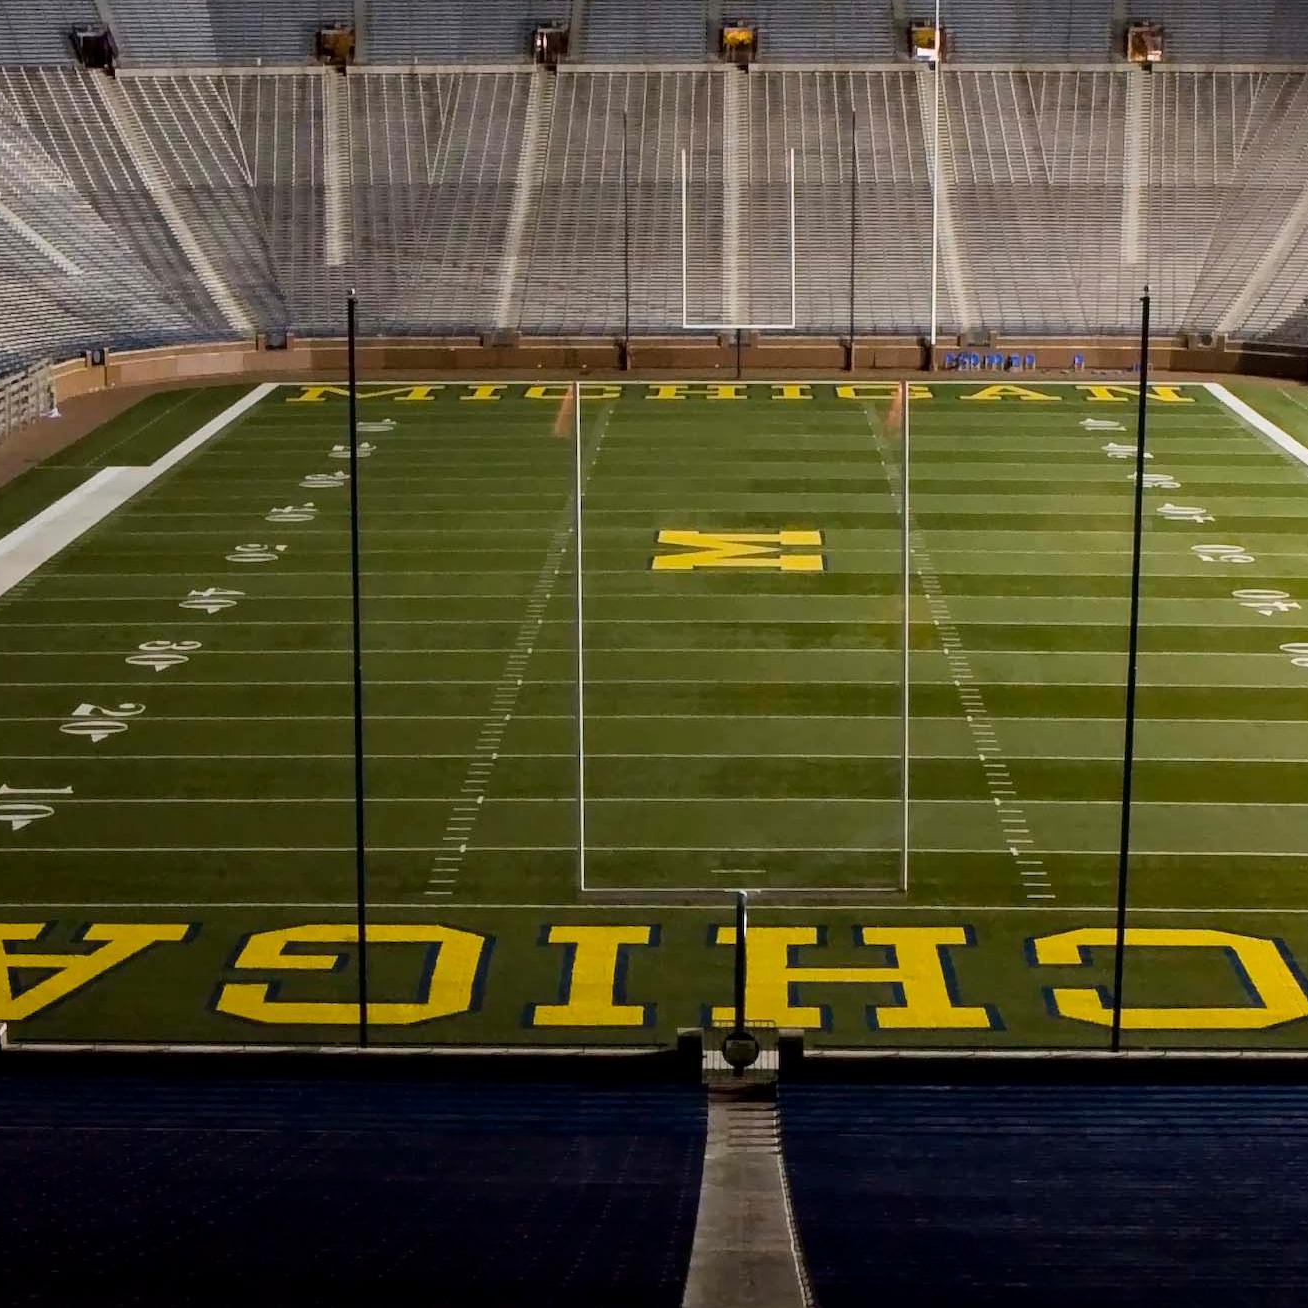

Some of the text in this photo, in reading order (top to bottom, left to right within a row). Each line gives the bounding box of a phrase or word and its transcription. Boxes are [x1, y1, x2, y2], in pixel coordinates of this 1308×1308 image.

[286, 383, 1196, 403] MICHIGAN
[225, 543, 288, 563] 50
[651, 529, 824, 571] M
[1191, 544, 1256, 563] 50
[178, 587, 246, 611] 40
[1231, 588, 1302, 613] 40
[125, 640, 203, 668] 30
[59, 702, 147, 737] 20
